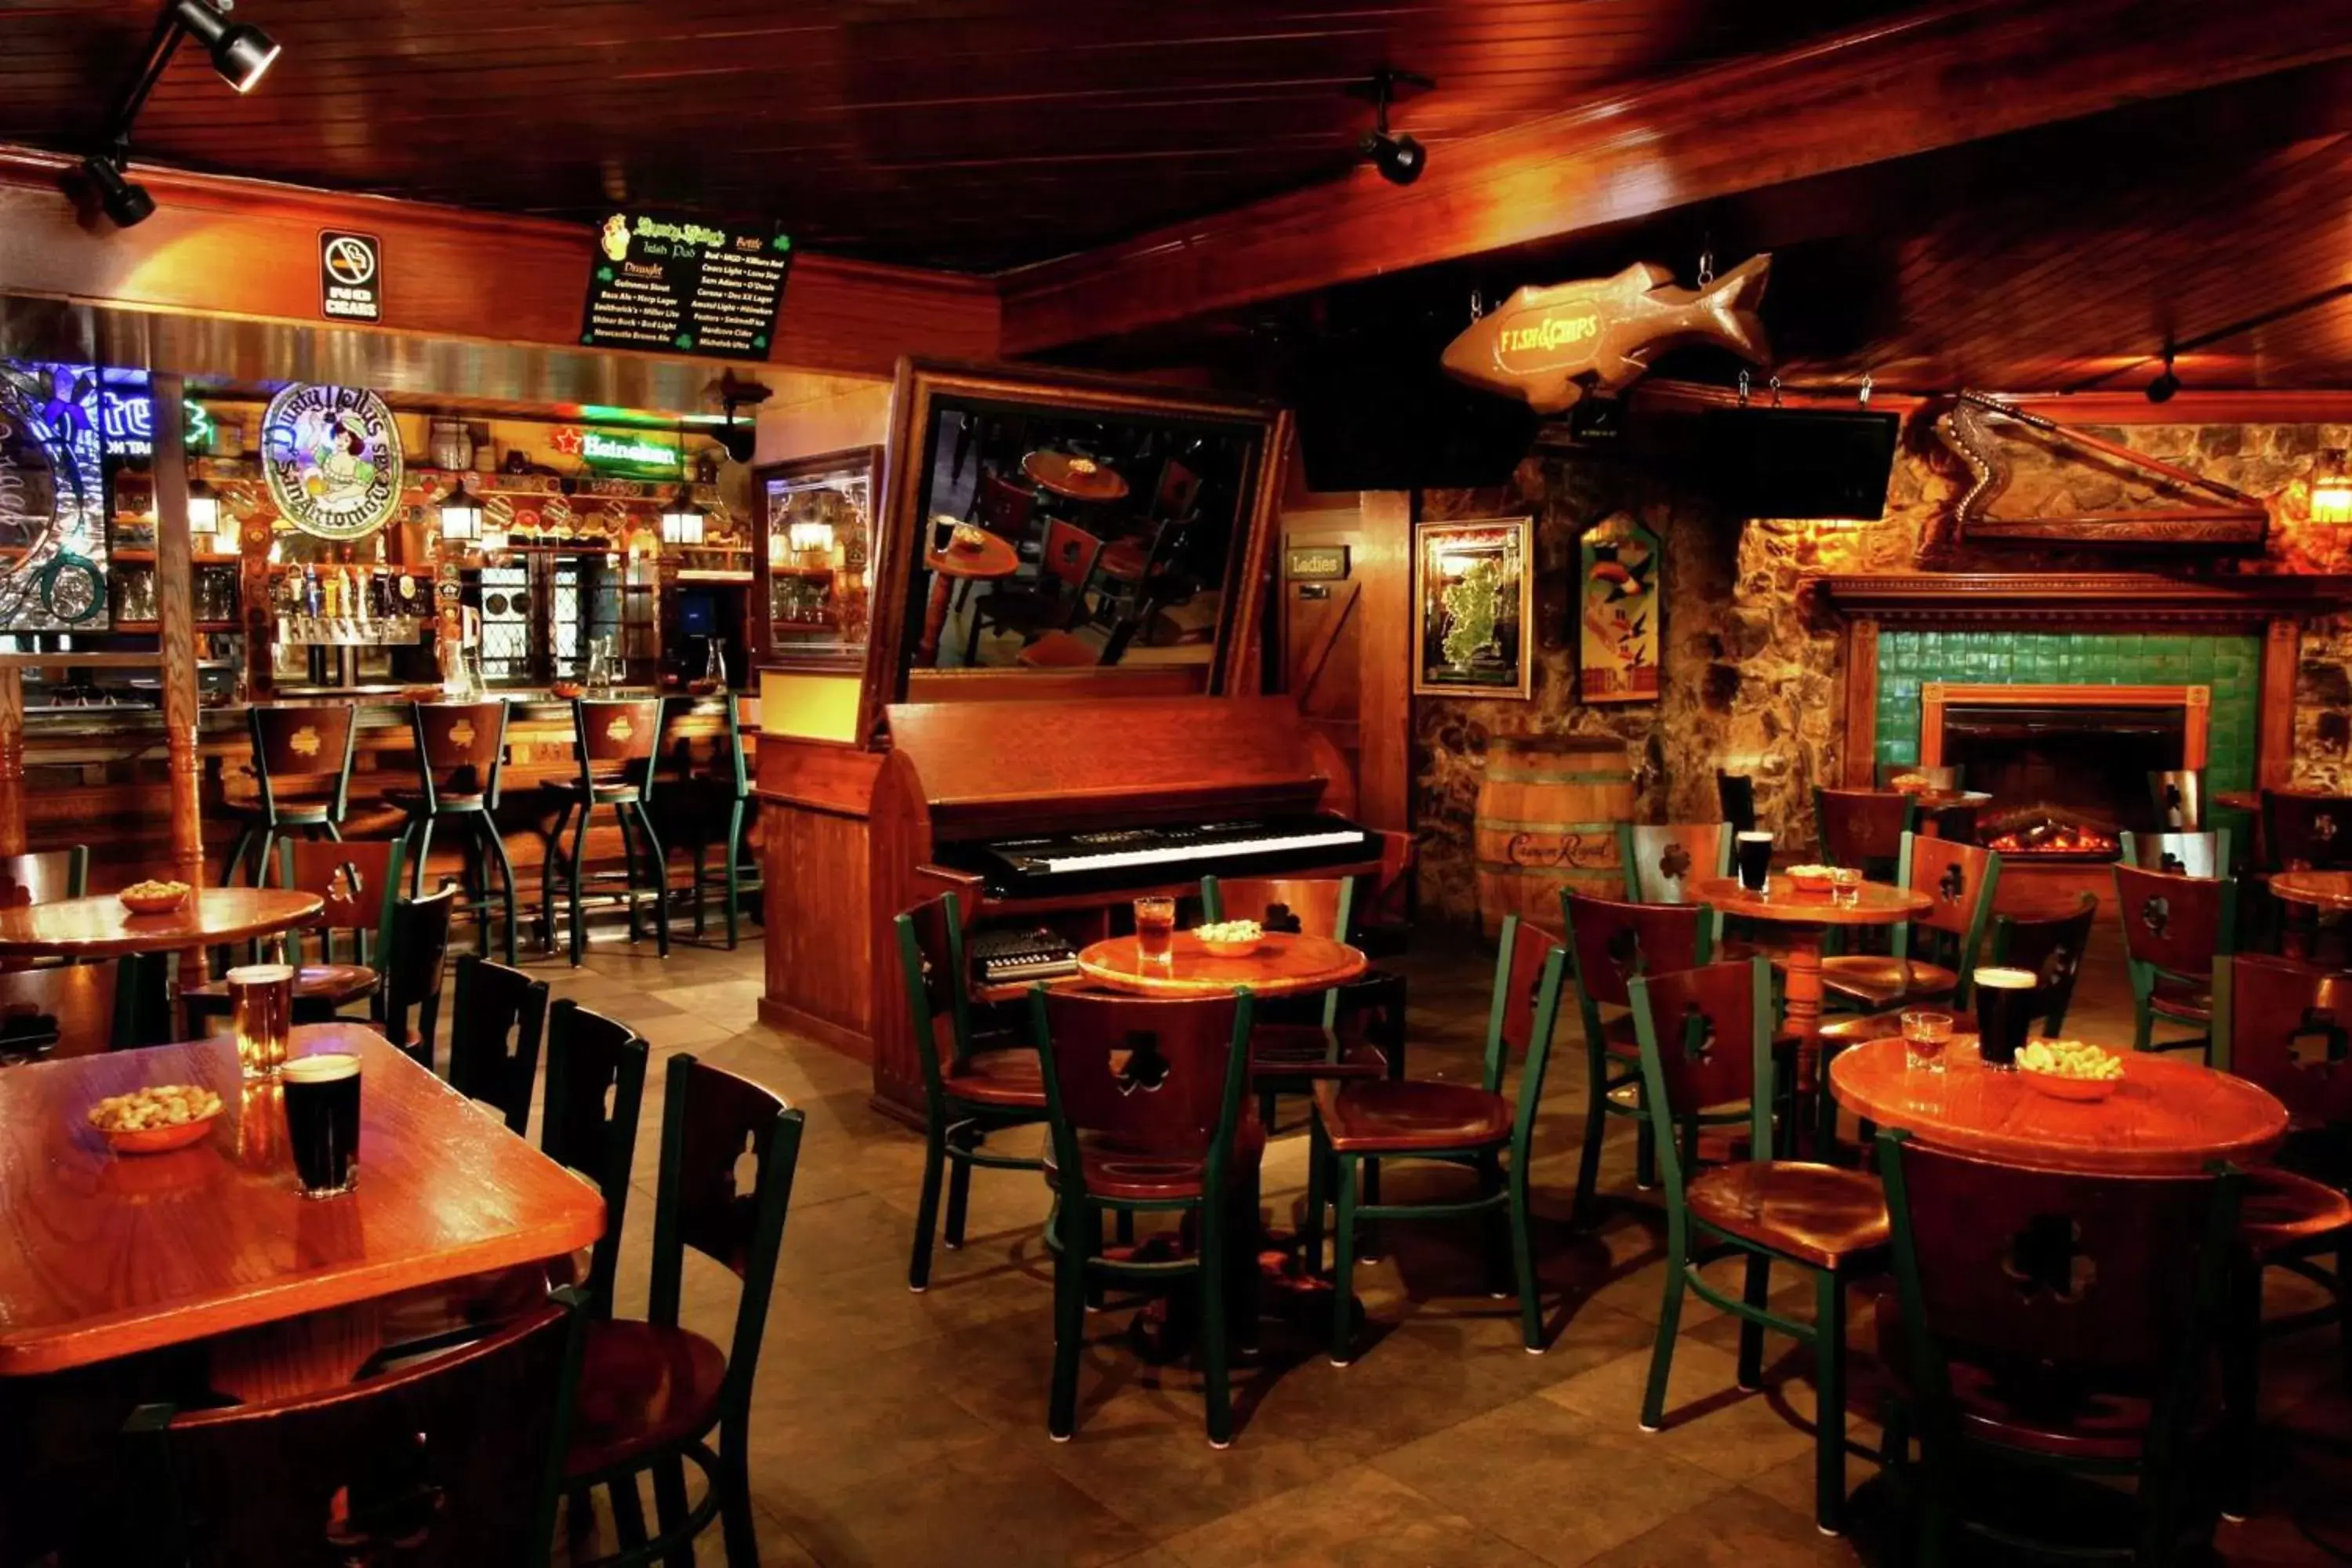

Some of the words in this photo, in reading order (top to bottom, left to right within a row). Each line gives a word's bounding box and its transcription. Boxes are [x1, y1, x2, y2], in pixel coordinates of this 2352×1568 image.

[644, 241, 667, 255] Irish
[672, 244, 695, 260] Pub
[724, 267, 742, 276] Light
[329, 287, 372, 302] NO
[325, 299, 376, 317] CIGARS
[717, 303, 736, 312] Light
[658, 322, 677, 331] Light
[583, 434, 677, 465] Heineken
[1293, 555, 1338, 573] Ladies
